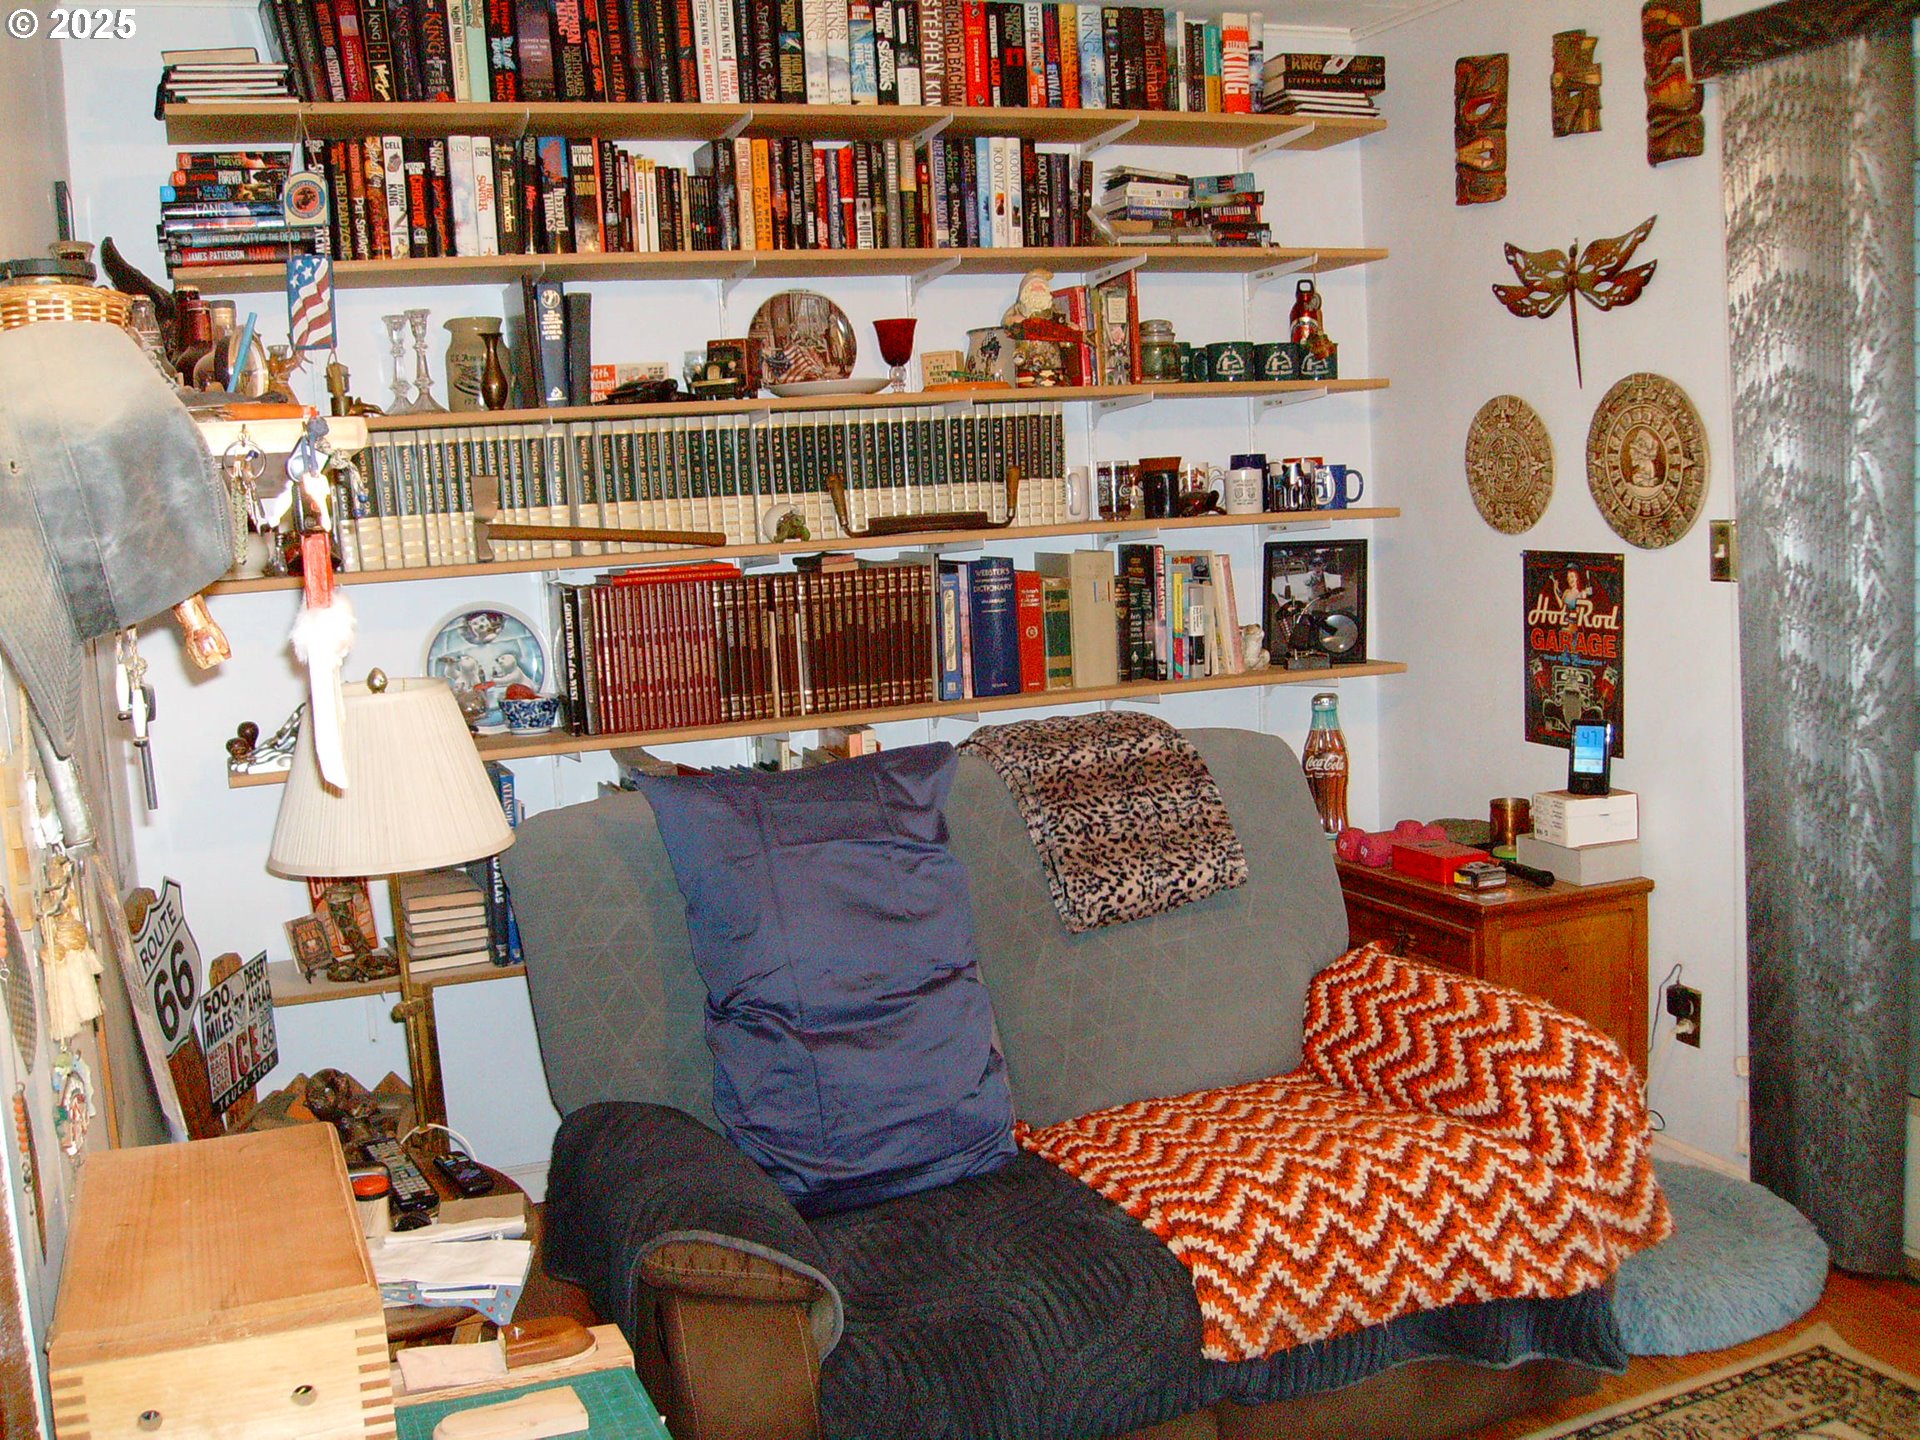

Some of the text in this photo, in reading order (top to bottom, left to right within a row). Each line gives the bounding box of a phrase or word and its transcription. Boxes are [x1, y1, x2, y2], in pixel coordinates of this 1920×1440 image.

[368, 13, 381, 40] KING
[423, 13, 442, 53] KING
[556, 1, 569, 36] KING
[875, 7, 884, 33] KING
[1029, 6, 1041, 66] STEPHEN KING
[701, 29, 714, 101] KING MERCEDES
[719, 33, 738, 102] KING FINDERS KEEPERS
[757, 43, 773, 69] KING
[1292, 61, 1322, 70] KING
[1223, 51, 1249, 95] KING
[573, 154, 593, 167] KING
[994, 148, 1004, 193] KOONTZ
[1010, 149, 1021, 192] KOONTZ
[1038, 156, 1048, 195] KOONTZ
[388, 184, 398, 206] KING
[575, 182, 596, 195] STAND
[604, 152, 615, 213] STEPHEN KING
[755, 187, 761, 197] OF
[195, 203, 228, 216] FANG
[354, 197, 365, 214] PET
[543, 192, 555, 232] THINGS
[281, 232, 300, 241] DEAD
[187, 246, 276, 261] JAMES PATTERSON HAWK
[835, 429, 843, 455] YEAR
[360, 451, 368, 483] WORLD
[403, 449, 411, 481] WORLD
[422, 448, 430, 480] WORLD
[448, 447, 456, 478] WORLD
[462, 447, 470, 477] WORLD
[501, 443, 509, 475] WORLD
[974, 567, 1013, 592] WEBSTER'S DICTIONARY
[564, 602, 579, 701] GHOST TOWNS WEST
[1531, 628, 1617, 659] GARAGE
[1306, 754, 1345, 771] Coca-Cola
[493, 870, 504, 903] ATLAS
[140, 900, 176, 973] ROUTE
[243, 955, 267, 991] DESERT
[154, 940, 194, 1042] 66
[204, 983, 230, 1023] 500
[248, 980, 273, 1016] AHEAD
[206, 1007, 234, 1050] MILES
[261, 1023, 275, 1050] 66
[207, 1041, 227, 1062] WATER
[209, 1056, 229, 1074] BAGS
[227, 1023, 261, 1086] ICE
[211, 1068, 230, 1088] COLD
[219, 1058, 275, 1111] TRUCK STOP
